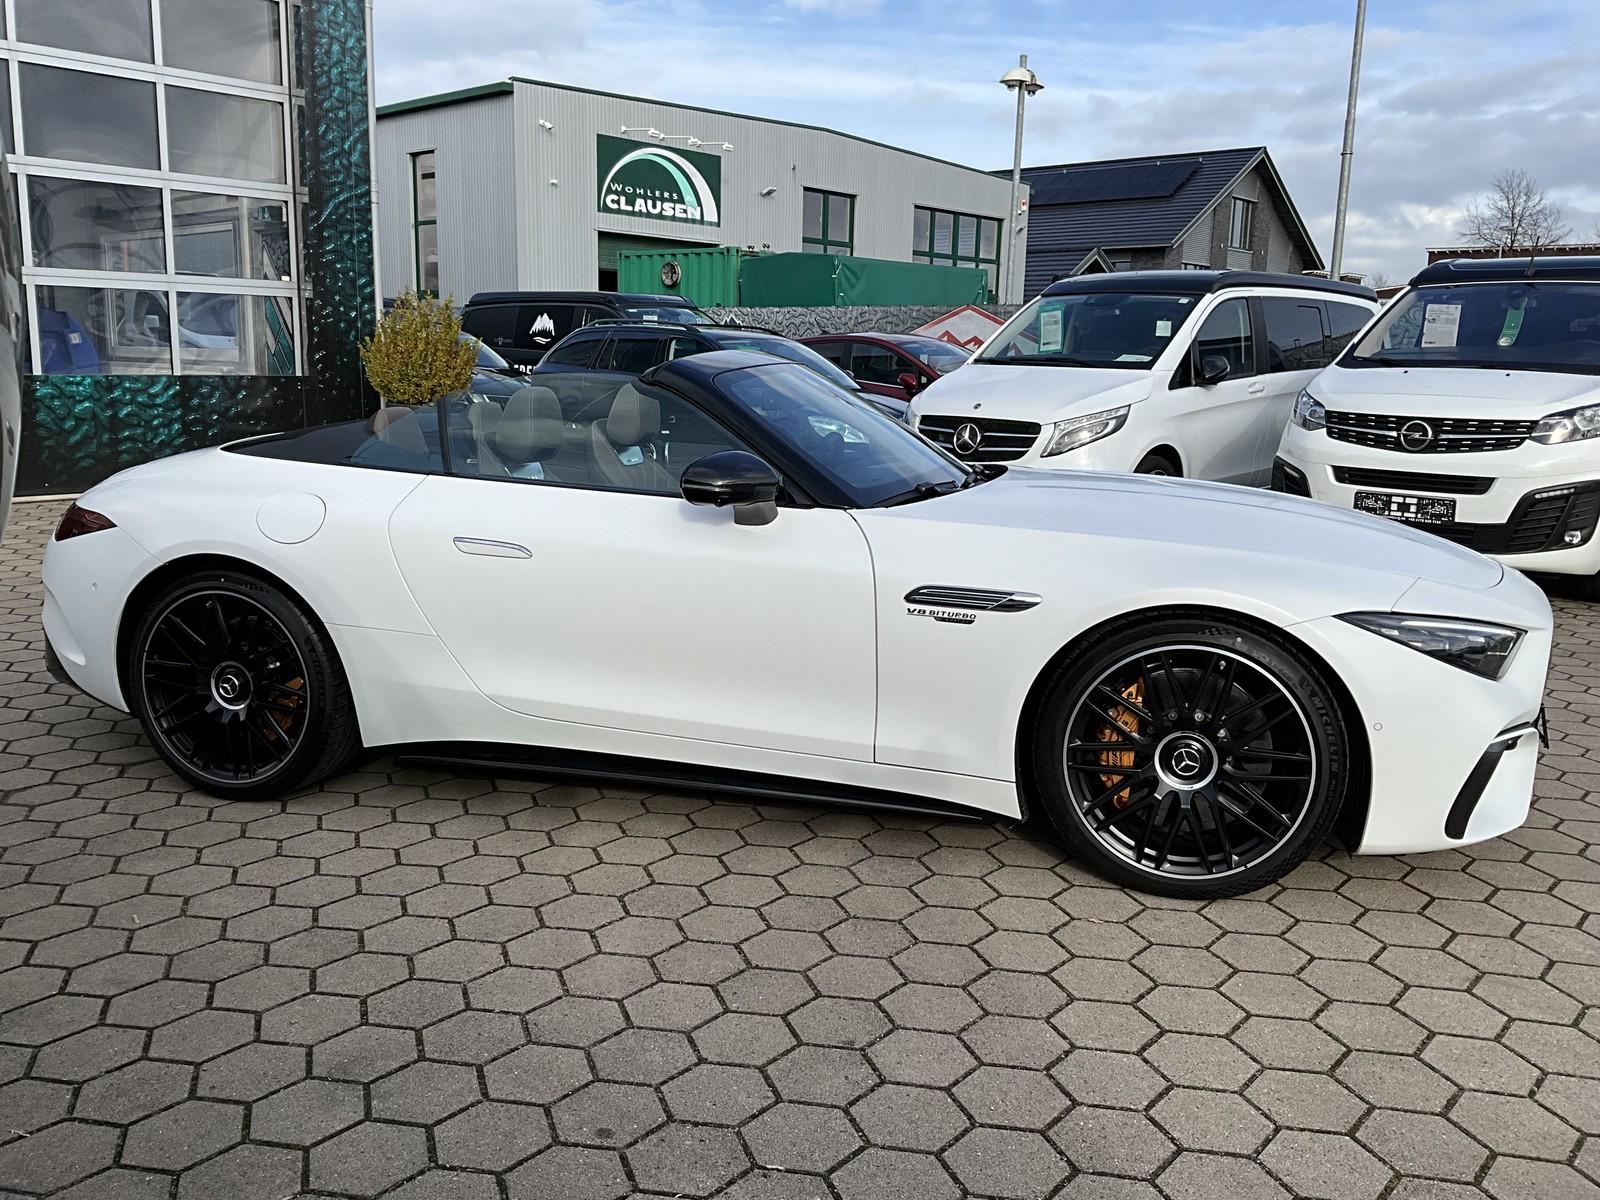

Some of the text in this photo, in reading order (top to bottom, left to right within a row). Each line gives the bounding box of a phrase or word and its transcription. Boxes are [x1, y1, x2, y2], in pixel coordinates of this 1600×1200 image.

[610, 182, 678, 199] WOHLERS
[605, 194, 701, 220] CLAUSEN
[906, 607, 976, 619] V8 BITURBO
